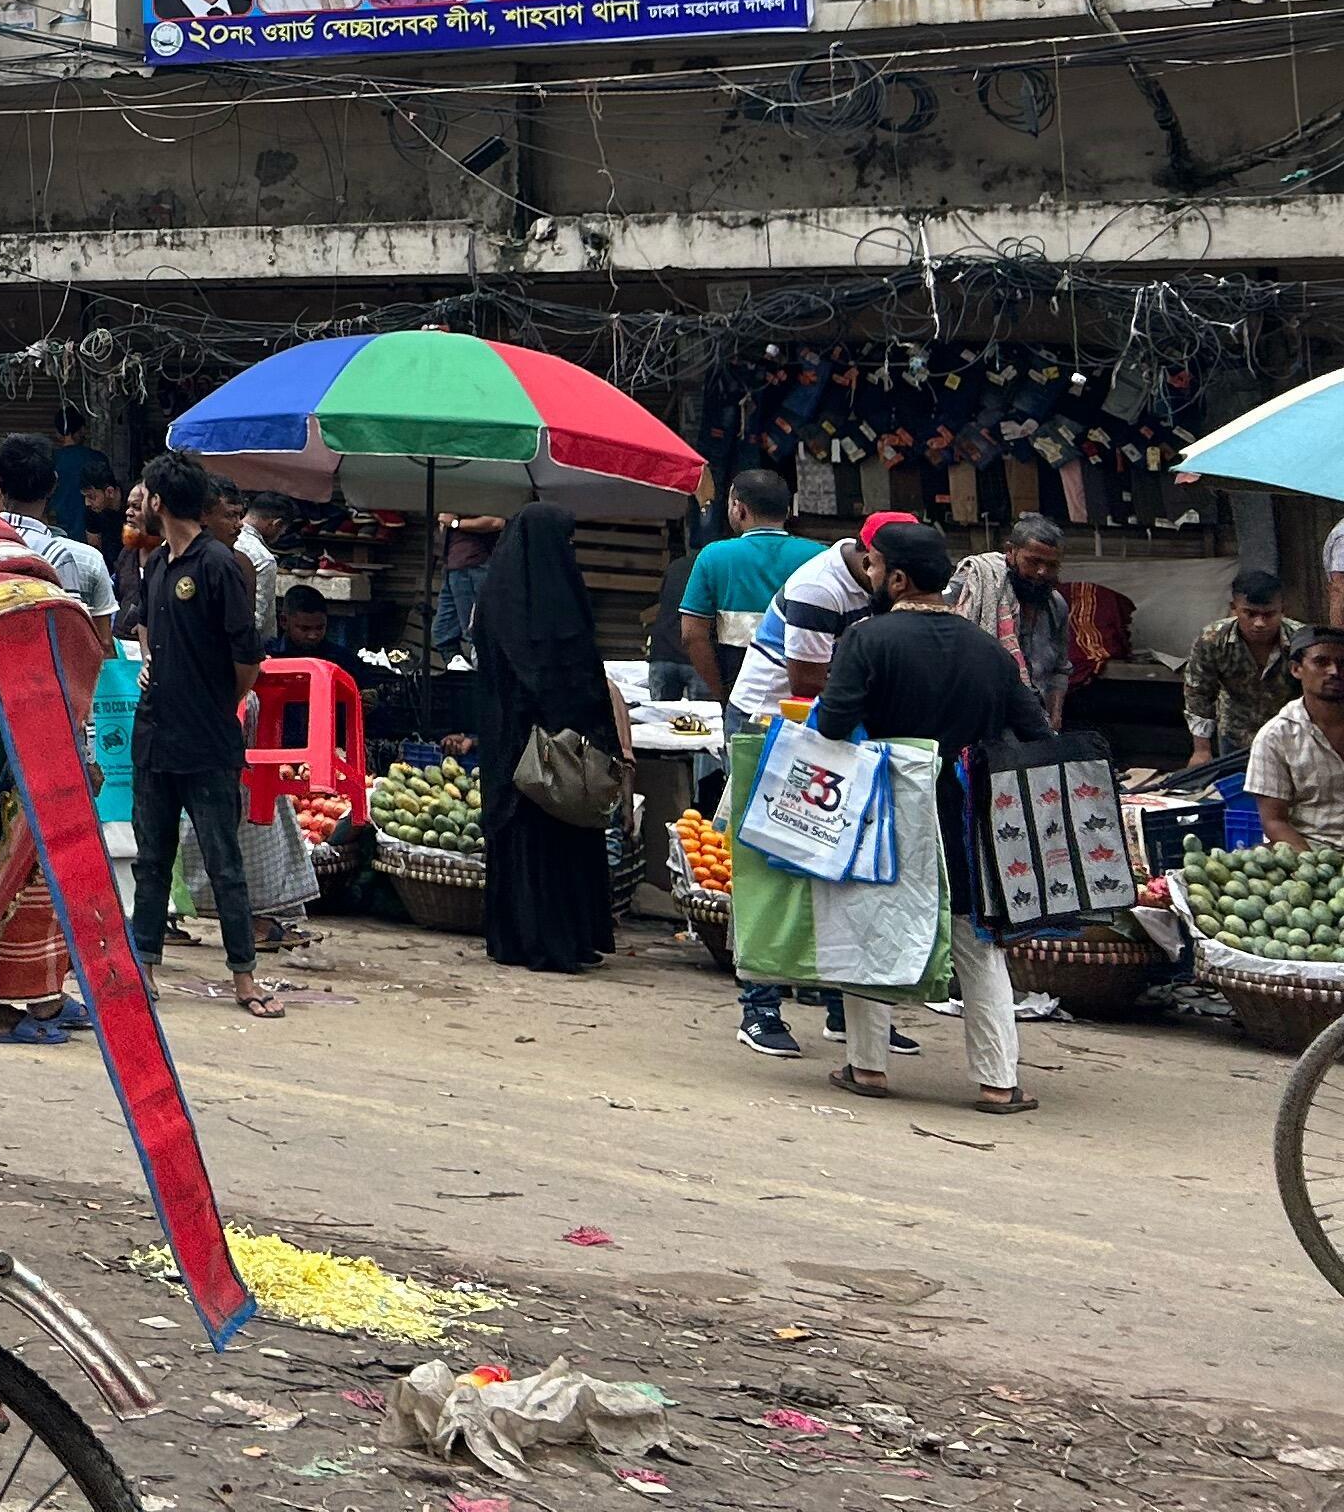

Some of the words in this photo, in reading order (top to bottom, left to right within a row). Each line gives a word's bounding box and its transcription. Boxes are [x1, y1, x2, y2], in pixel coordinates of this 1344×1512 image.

[188, 21, 256, 50] ২০নং
[261, 15, 317, 43] ওয়ার্ড
[322, 13, 438, 40] স্বেচ্ছাসেবক
[444, 5, 496, 36] লীগ,
[504, 1, 584, 30] শাহবাগ
[647, 5, 679, 20] ঢাকা
[683, 0, 740, 18] মহানগর
[771, 809, 809, 832] Adarsha
[811, 826, 840, 845] School
